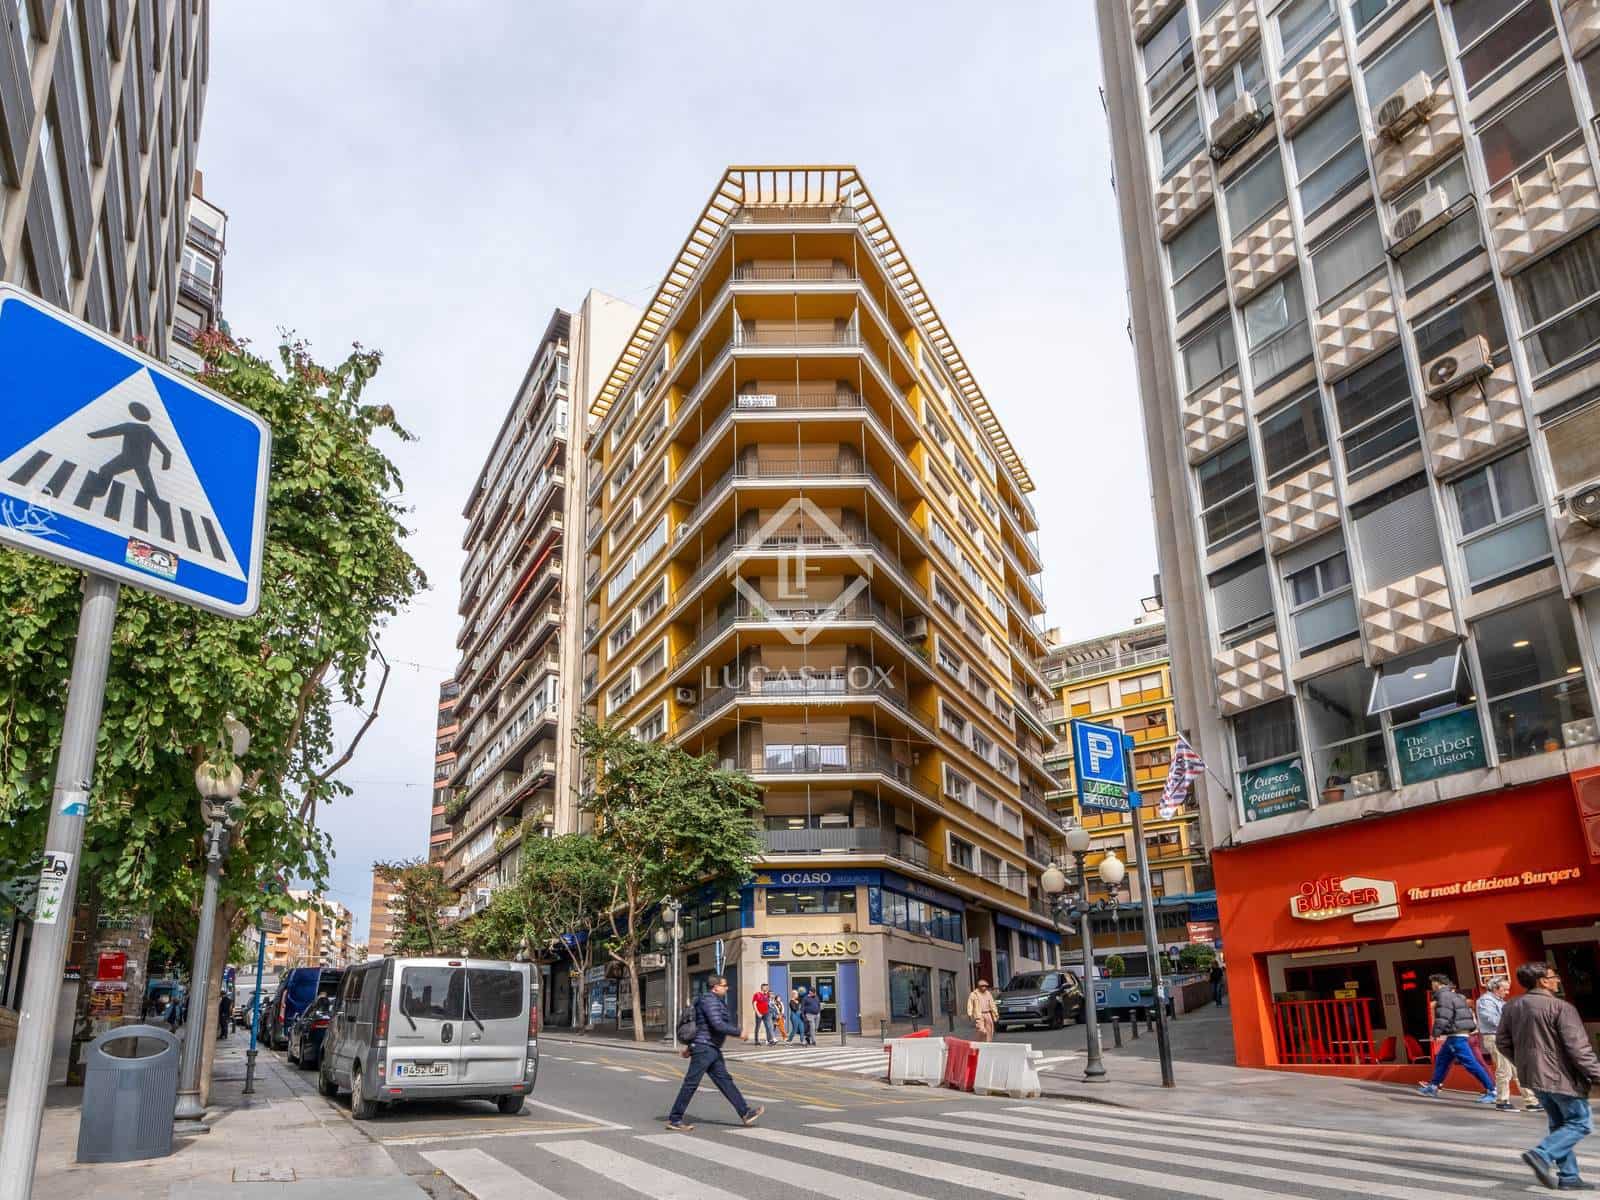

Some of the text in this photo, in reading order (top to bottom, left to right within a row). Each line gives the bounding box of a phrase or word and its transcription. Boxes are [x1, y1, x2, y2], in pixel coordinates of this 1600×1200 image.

[1404, 736, 1428, 747] The
[1408, 735, 1475, 762] Barber
[1087, 732, 1113, 773] P
[1432, 750, 1475, 767] History
[1254, 773, 1289, 790] Cursos
[781, 872, 831, 884] OCASO
[1299, 876, 1342, 896] ONE
[1407, 867, 1581, 901] The most delicious Burgers
[1297, 886, 1380, 912] BURGER
[792, 940, 861, 957] OCASO
